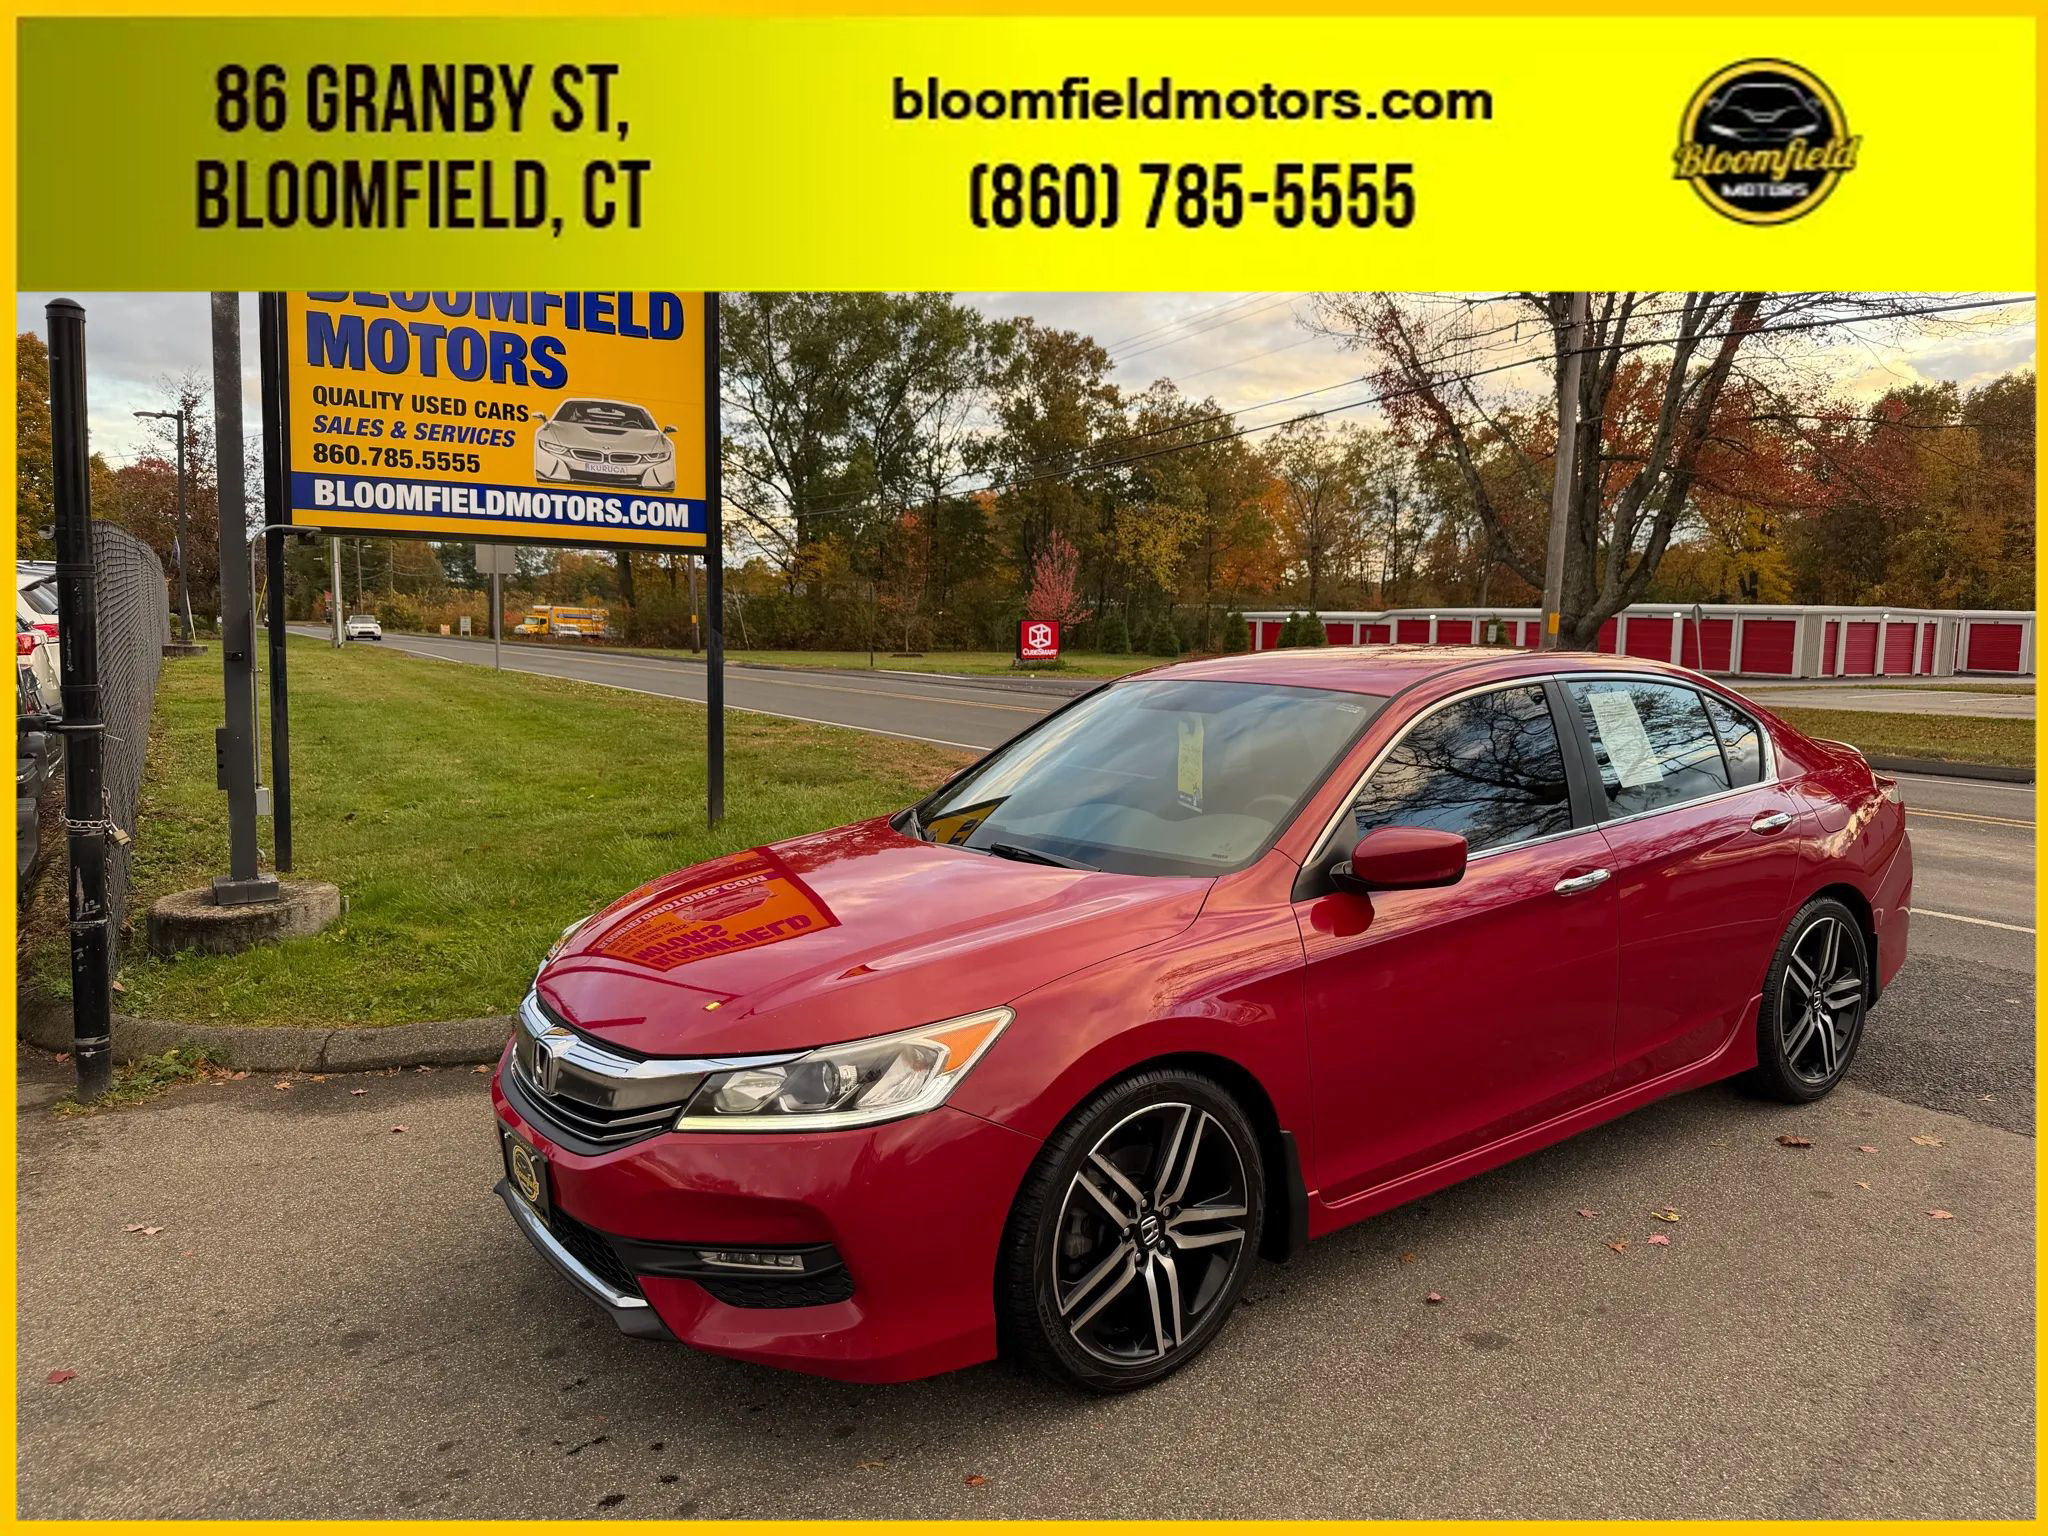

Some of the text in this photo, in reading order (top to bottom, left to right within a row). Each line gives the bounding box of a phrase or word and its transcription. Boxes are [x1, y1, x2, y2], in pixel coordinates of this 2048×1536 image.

[306, 291, 685, 341] MFIELD
[306, 310, 569, 390] MOTORS
[312, 385, 529, 422] QUALITY USED CARS
[312, 414, 516, 448] SALES & SERVICES
[312, 443, 481, 473] 860.785.5555
[313, 479, 690, 528] BLOOMFIELDMOTORS.COM
